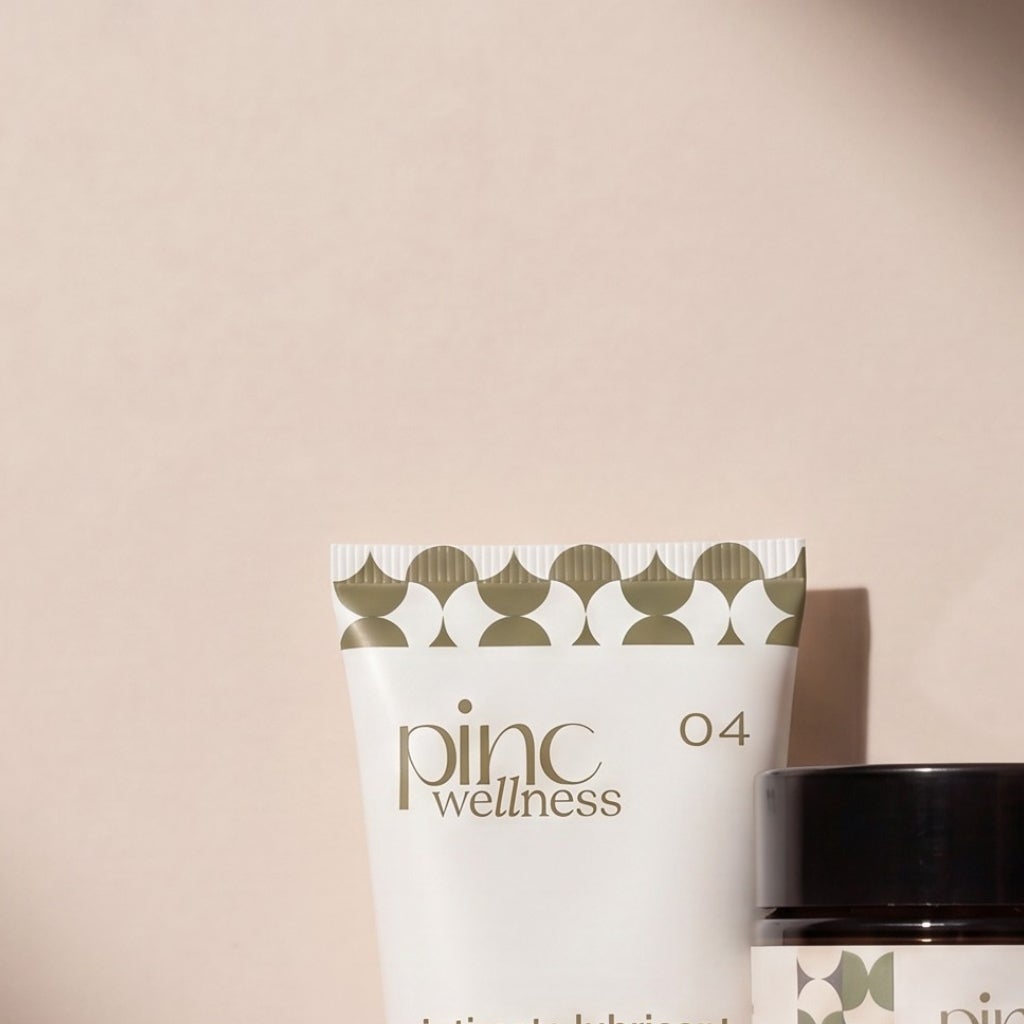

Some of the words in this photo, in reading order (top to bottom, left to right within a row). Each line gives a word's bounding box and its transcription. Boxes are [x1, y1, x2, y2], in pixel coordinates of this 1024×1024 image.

[679, 710, 751, 747] 04
[398, 698, 603, 811] pinc
[432, 775, 622, 818] wellness
